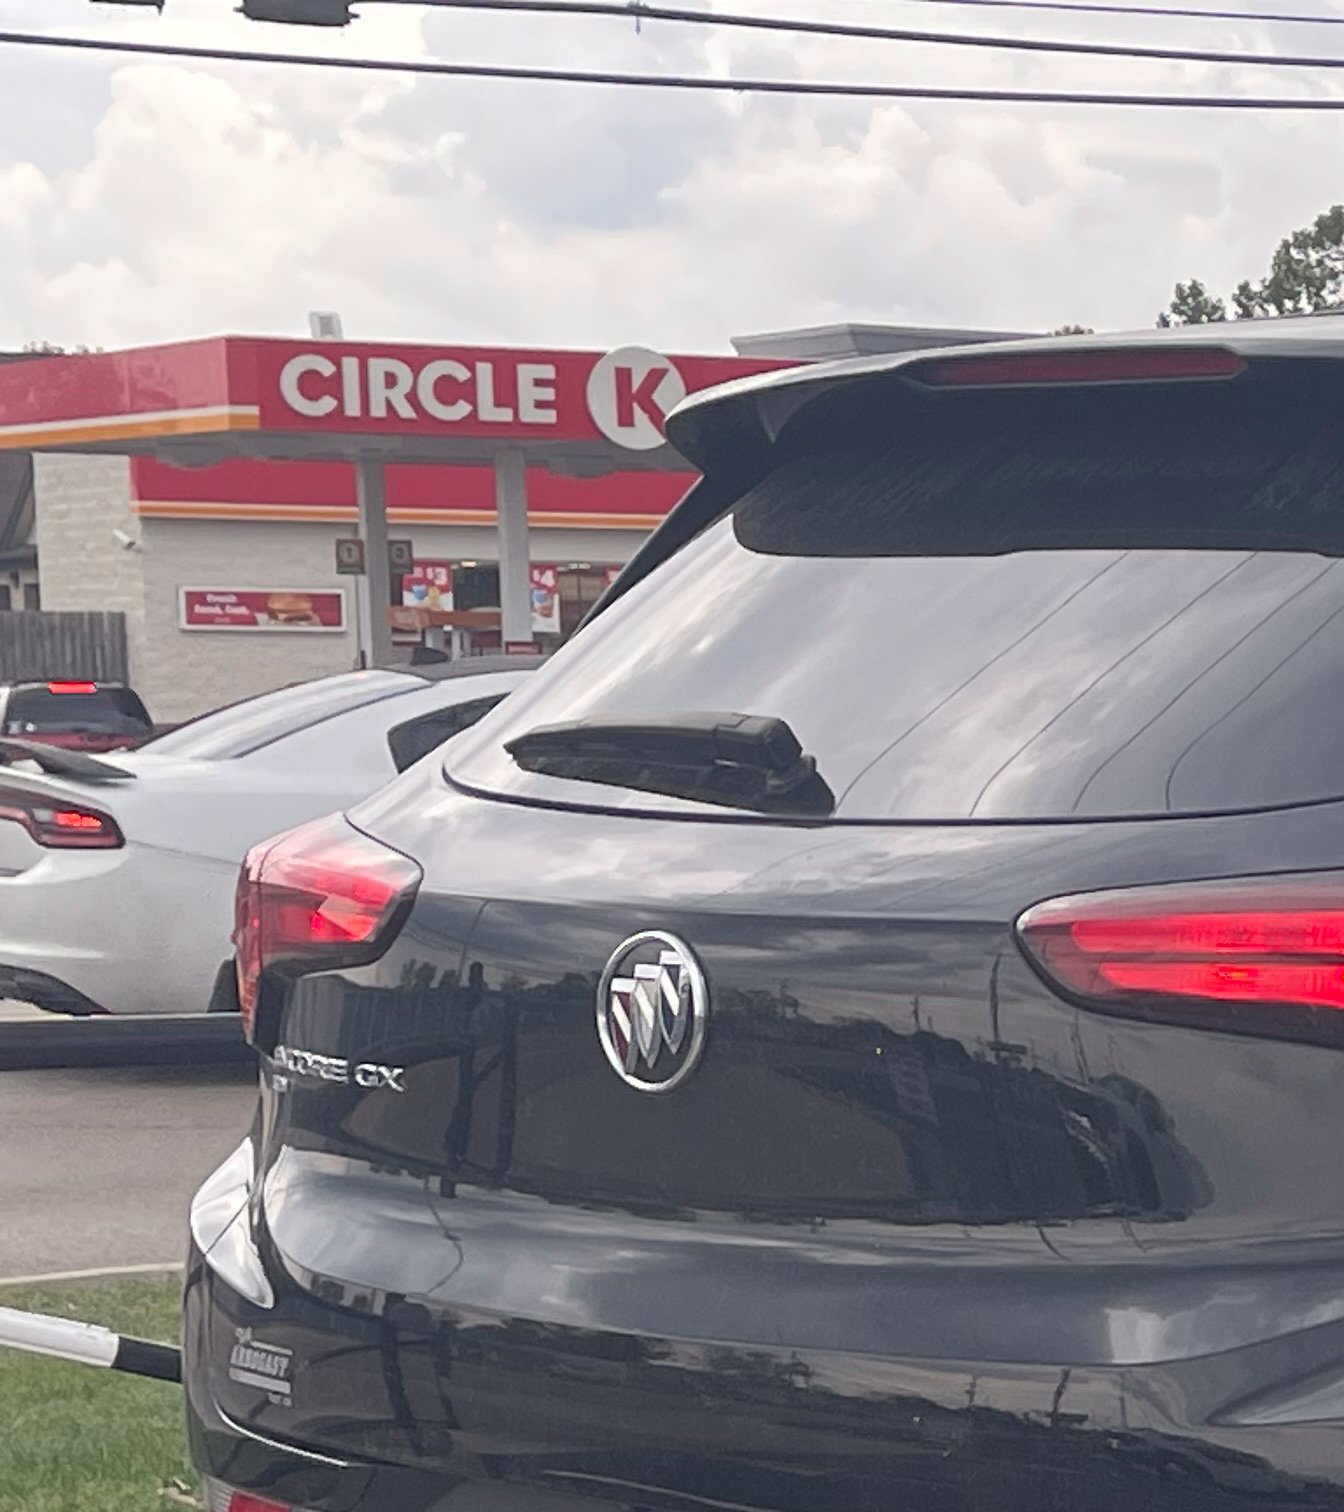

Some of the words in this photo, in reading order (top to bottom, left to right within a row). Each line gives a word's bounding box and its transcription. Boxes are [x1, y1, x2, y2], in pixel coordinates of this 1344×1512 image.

[279, 354, 557, 423] CIRCLE
[613, 366, 669, 437] K
[354, 1062, 408, 1092] GX
